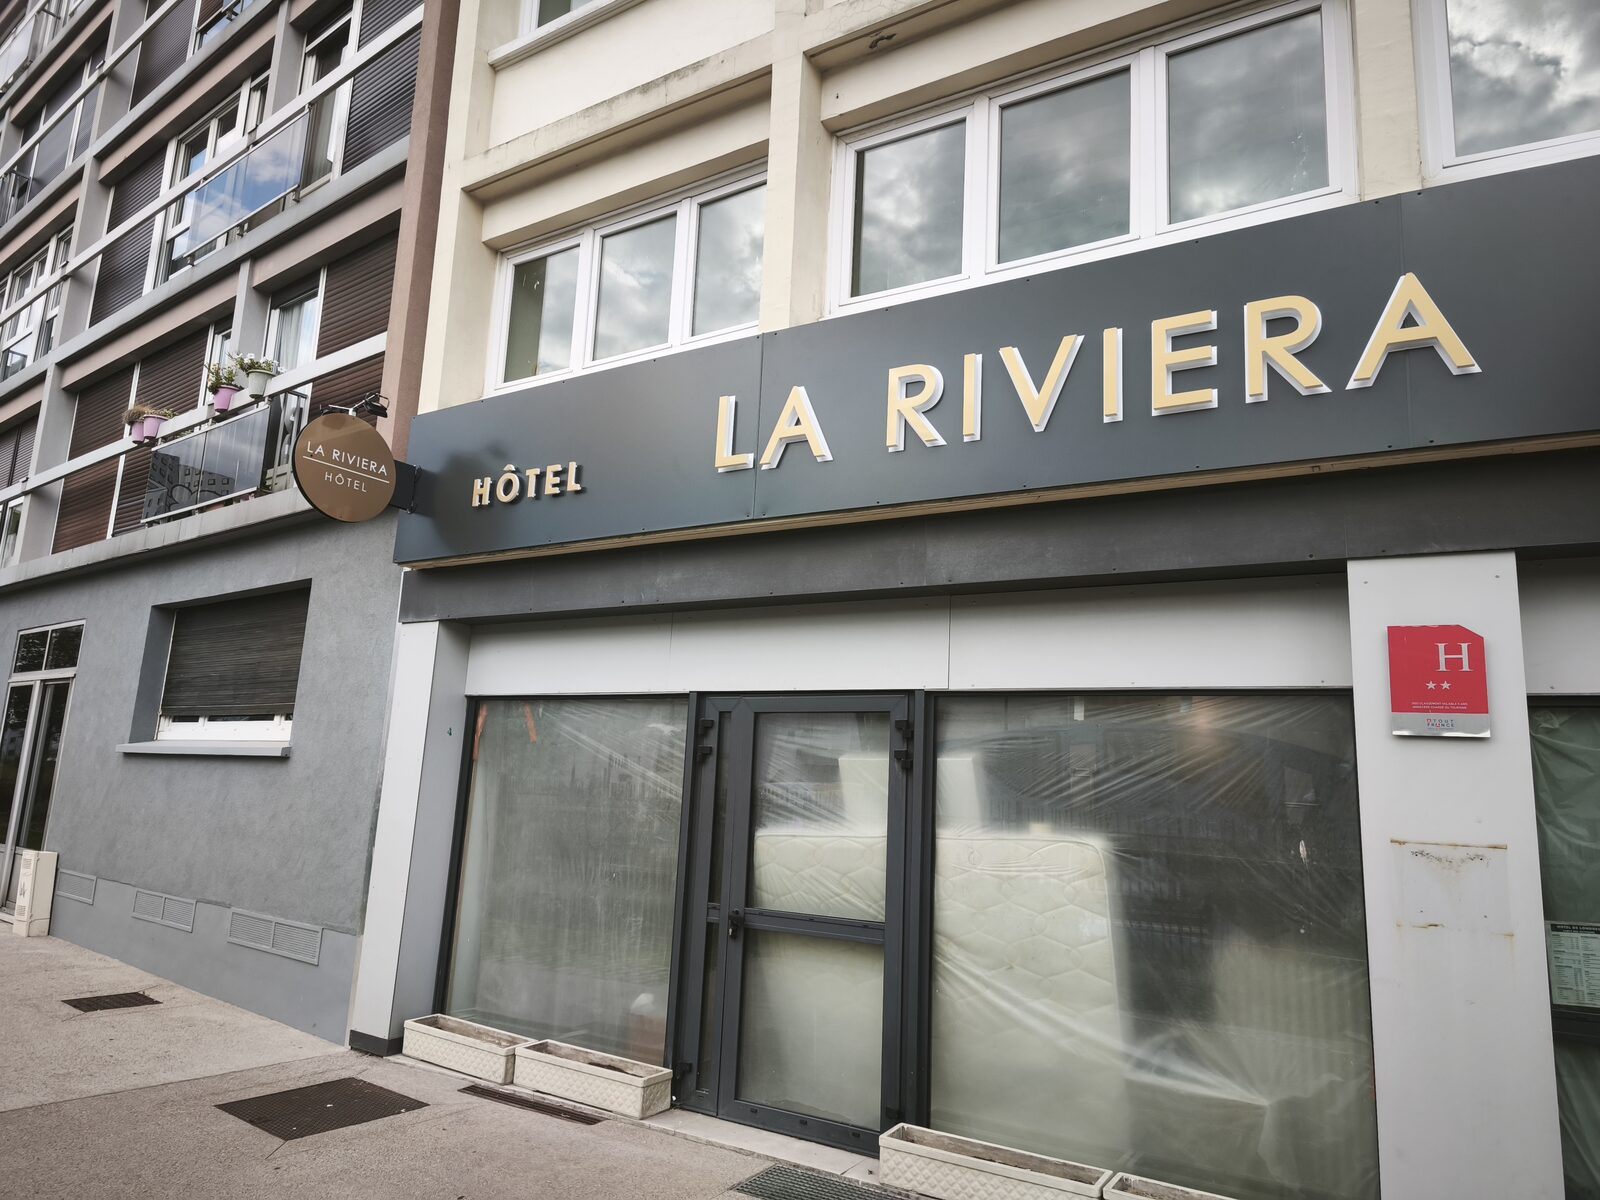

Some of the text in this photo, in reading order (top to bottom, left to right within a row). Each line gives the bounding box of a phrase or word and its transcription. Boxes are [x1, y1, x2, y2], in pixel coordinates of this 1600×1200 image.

[715, 272, 1483, 473] LA RIVIERA
[307, 441, 388, 476] LA RIVIERA
[324, 471, 367, 493] HÔTEL
[471, 461, 582, 507] HÔTEL
[1434, 642, 1474, 672] H
